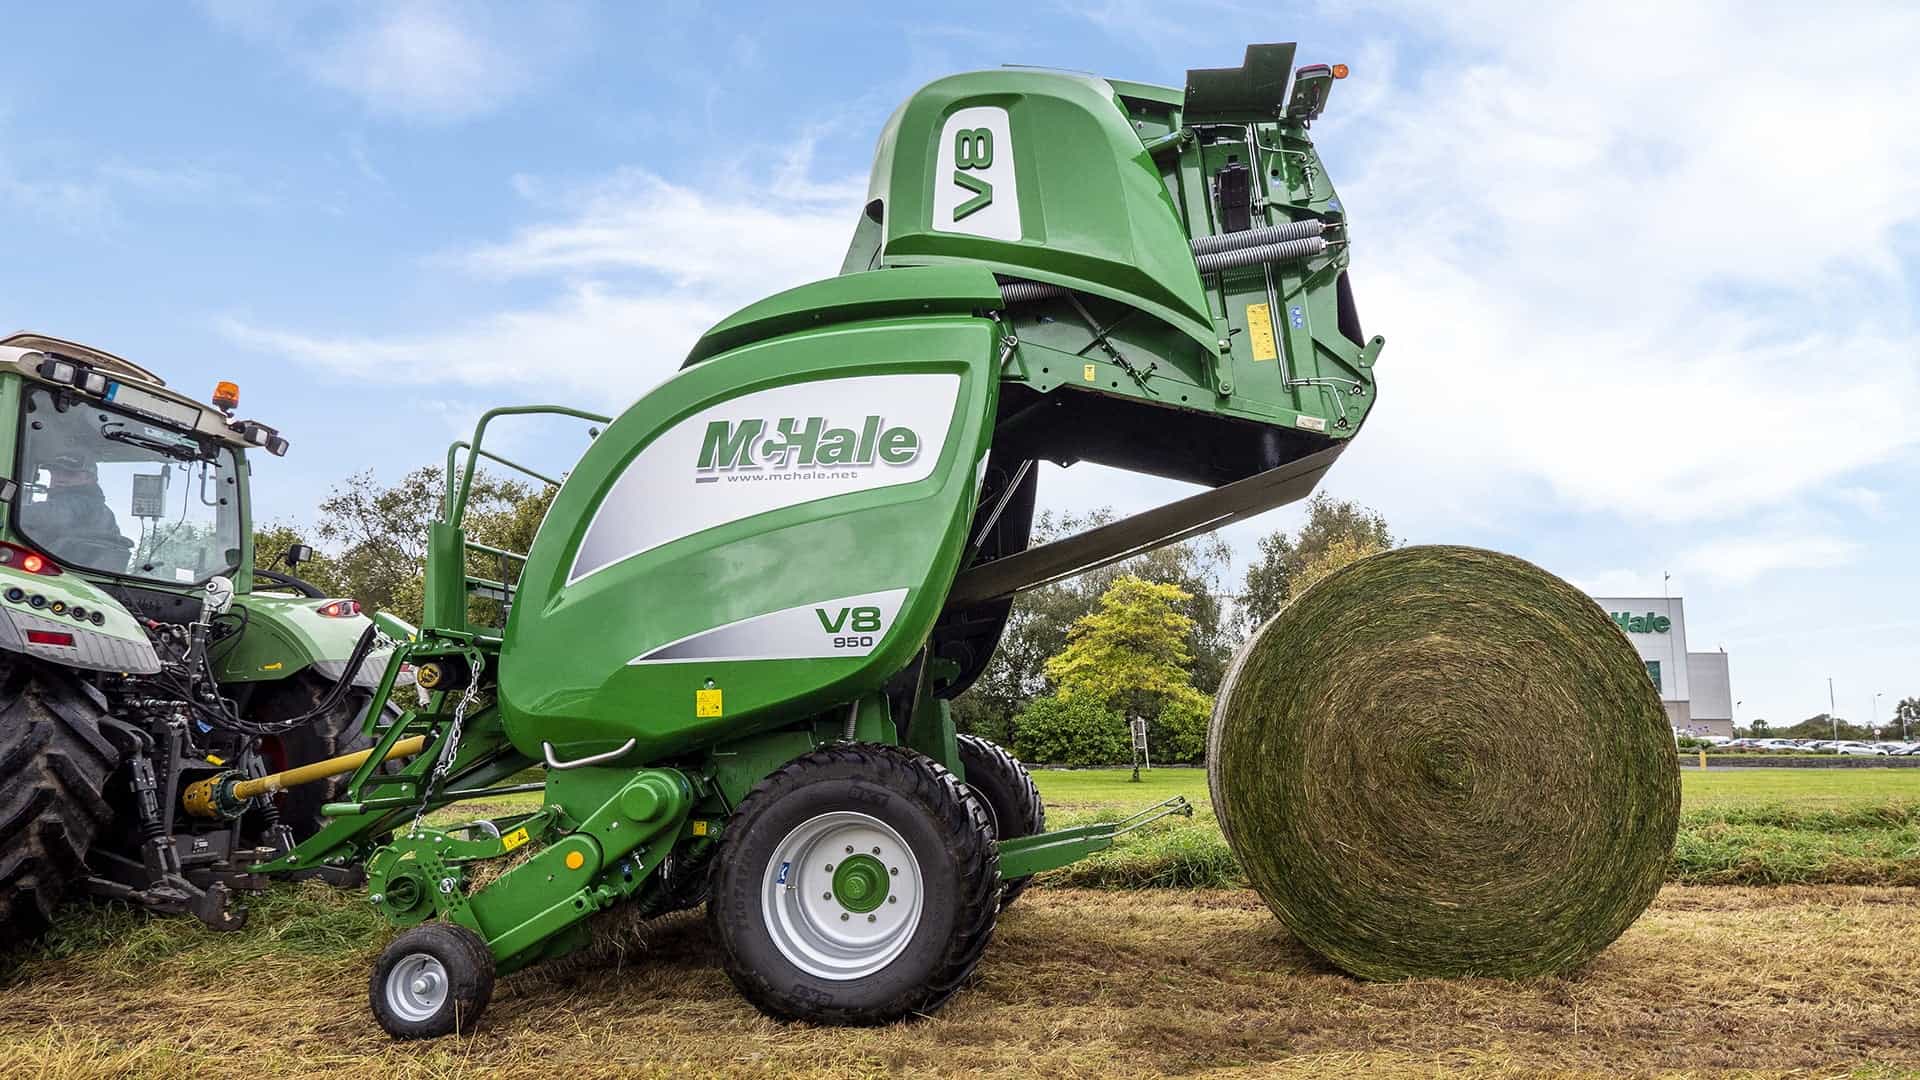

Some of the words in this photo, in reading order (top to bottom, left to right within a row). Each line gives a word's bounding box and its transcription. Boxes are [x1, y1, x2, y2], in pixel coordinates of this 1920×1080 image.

[953, 127, 993, 222] V8
[696, 415, 918, 469] McHale
[727, 471, 858, 483] www.mchale.net
[815, 606, 882, 634] V8
[833, 636, 873, 648] 950
